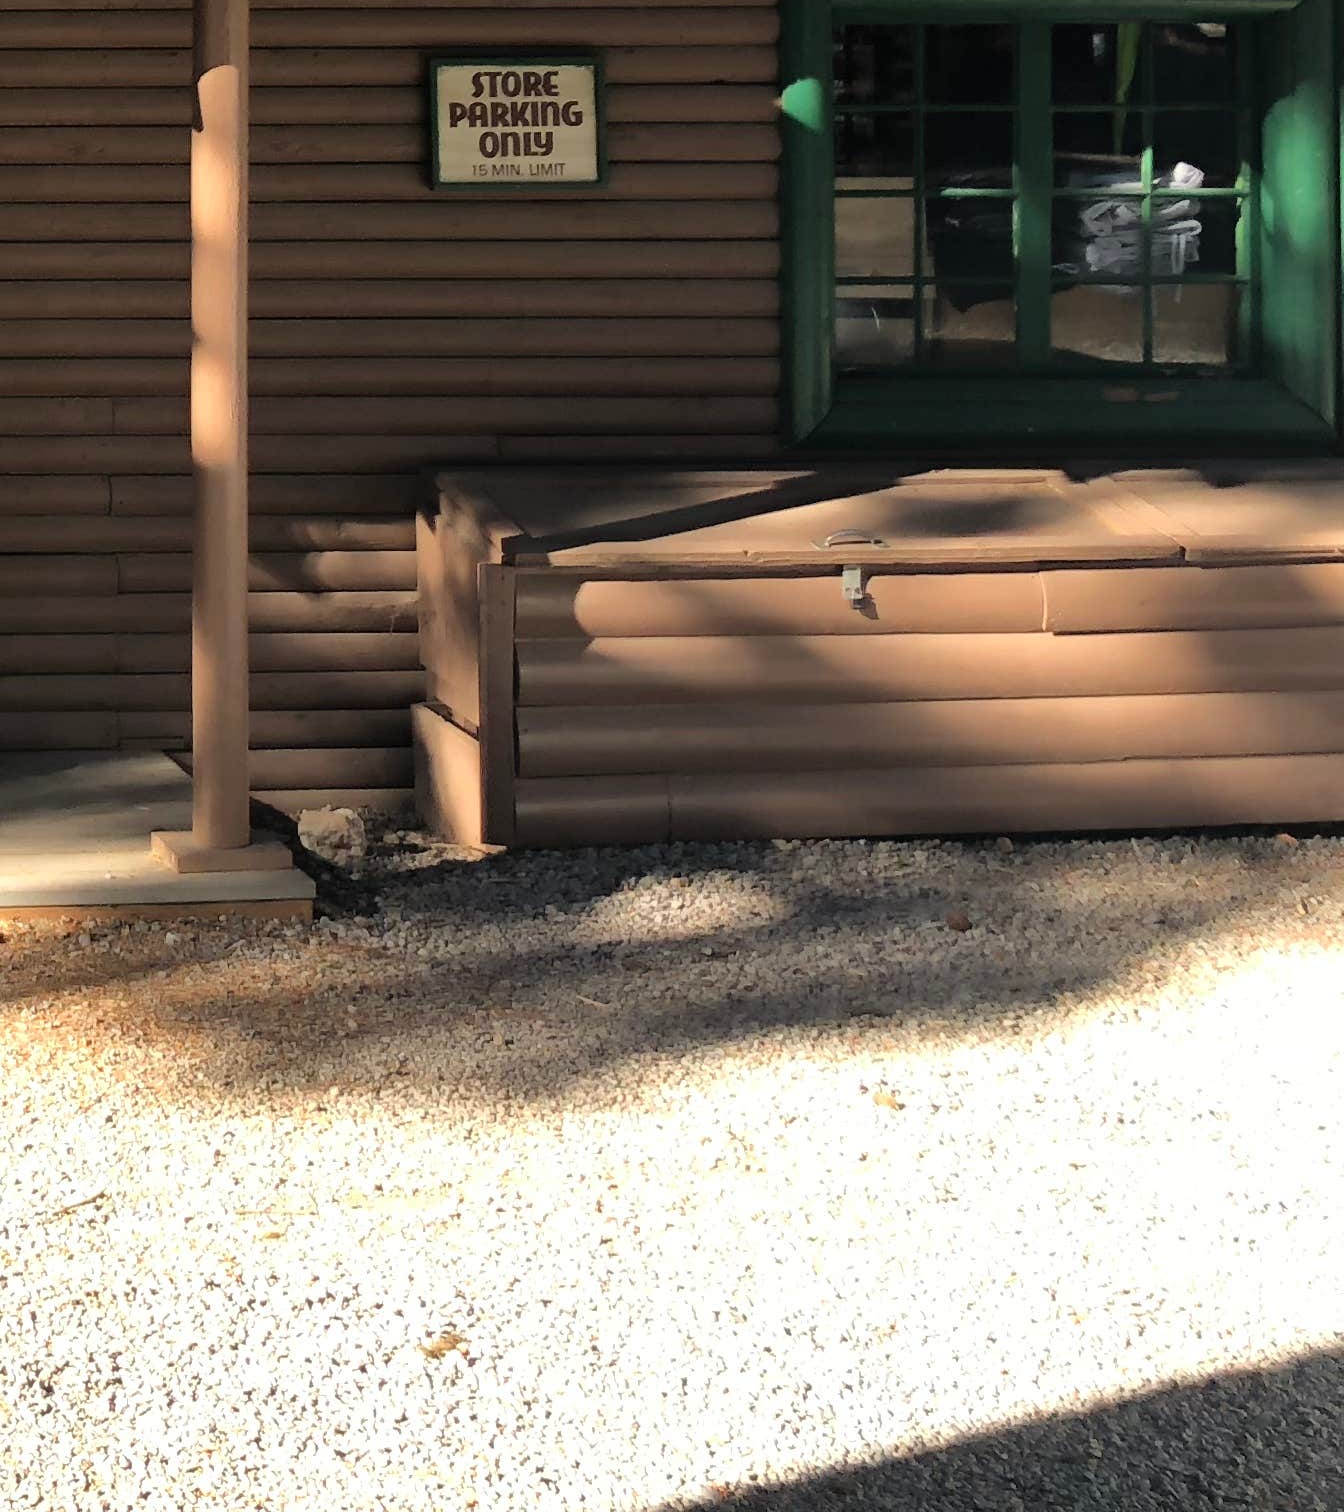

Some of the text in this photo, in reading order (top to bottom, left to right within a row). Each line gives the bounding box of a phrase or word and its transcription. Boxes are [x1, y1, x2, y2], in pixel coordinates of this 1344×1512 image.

[471, 70, 560, 99] STORE
[448, 100, 584, 128] PARKING
[478, 131, 554, 159] ONLY
[472, 162, 566, 177] 15 MIN. LIMIT
